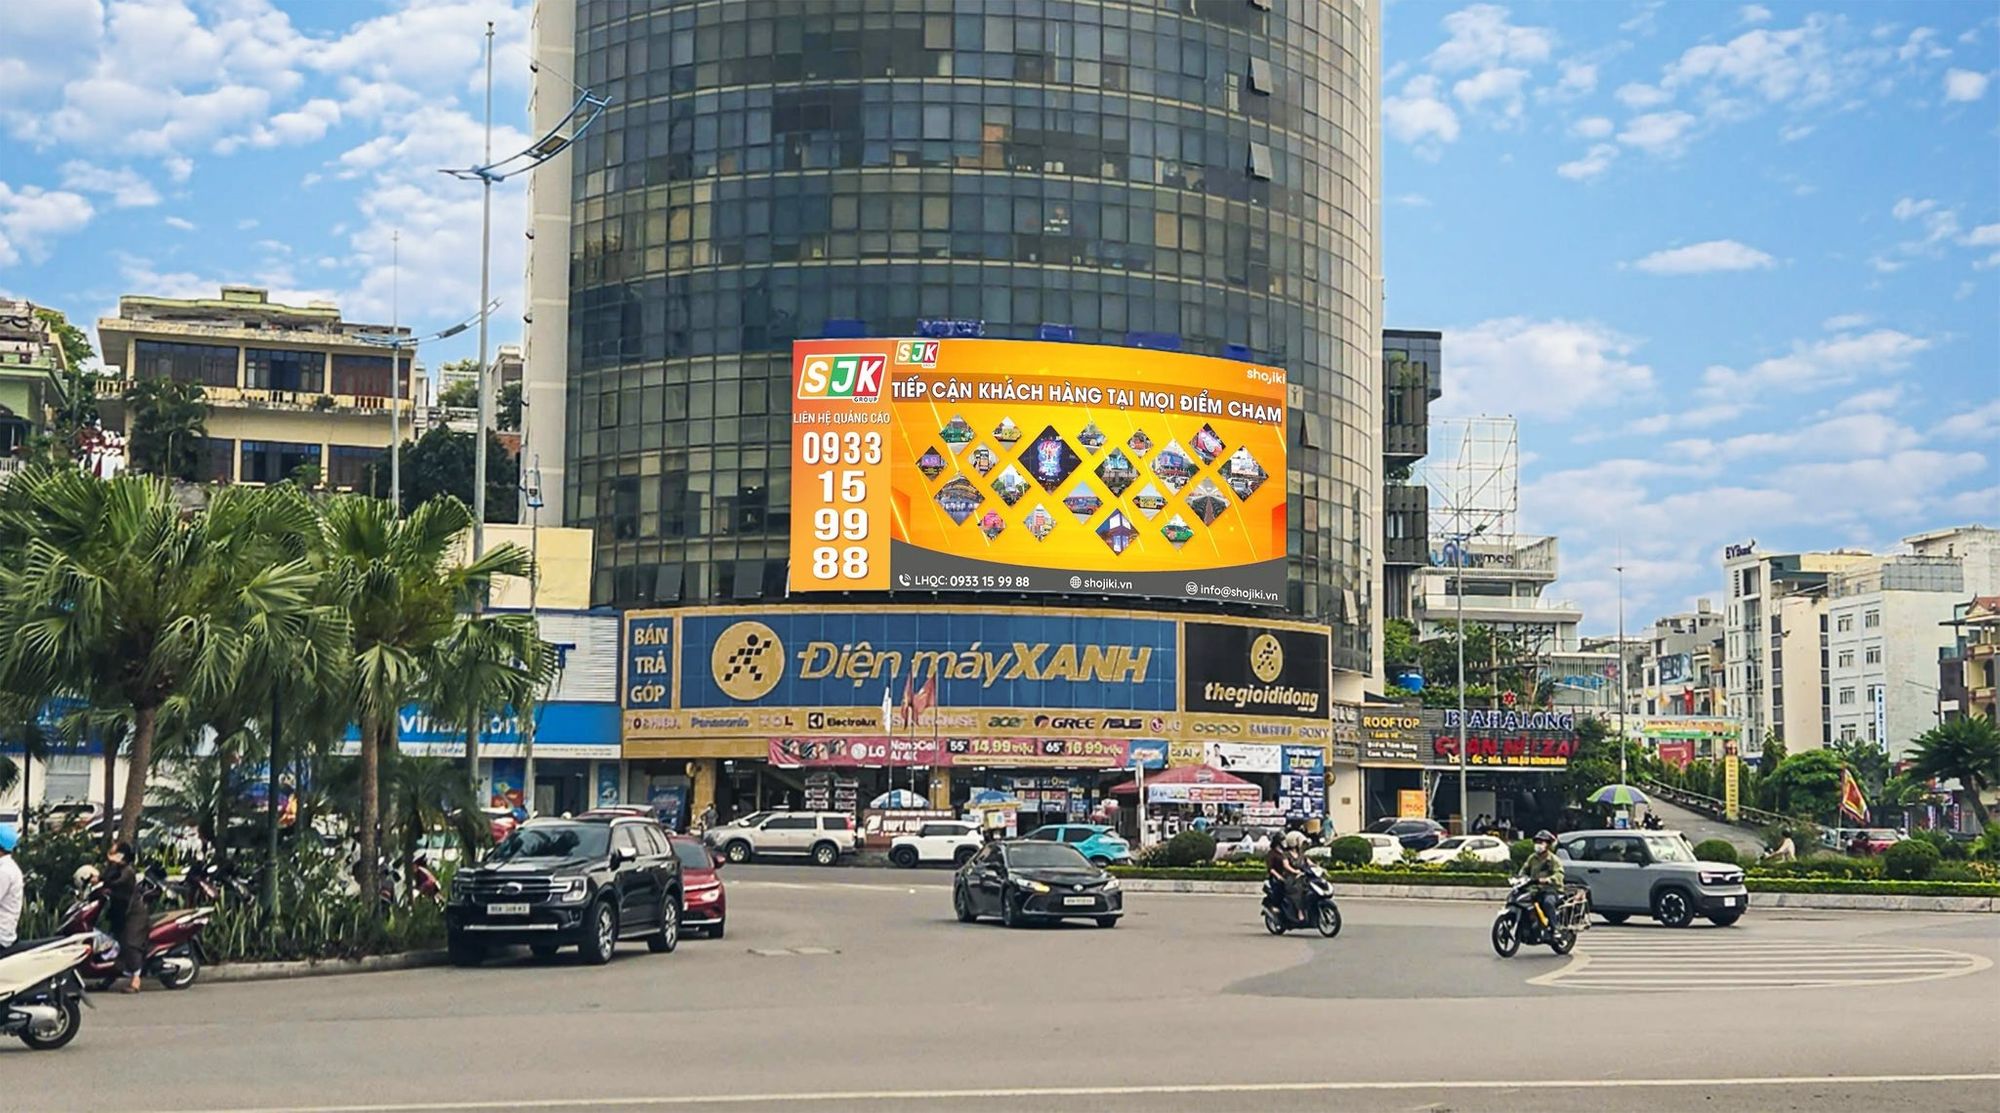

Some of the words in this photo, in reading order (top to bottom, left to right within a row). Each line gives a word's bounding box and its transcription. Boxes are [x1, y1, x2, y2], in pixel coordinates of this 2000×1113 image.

[898, 343, 939, 362] SJK
[804, 360, 883, 393] SJK
[1246, 368, 1287, 385] shojiki
[892, 375, 927, 398] TIẾP
[931, 377, 972, 403] CẬN
[978, 379, 1043, 401] KHÁCH
[1049, 379, 1103, 404] HÀNG
[1107, 387, 1135, 410] TẠI
[1139, 391, 1175, 413] MỌI
[1180, 389, 1222, 415] ĐIỂM
[1227, 400, 1282, 424] CHẠM
[793, 411, 816, 423] LIÊN
[818, 411, 831, 426] HỆ
[870, 410, 890, 424] CÁO
[802, 431, 882, 465] 0933
[818, 470, 867, 503] 15
[814, 508, 869, 541] 99
[812, 546, 869, 580] 88
[915, 575, 948, 587] LHQC:
[950, 575, 979, 587] 0933
[982, 575, 994, 587] 15
[998, 576, 1012, 587] 99
[1015, 576, 1030, 587] 88
[1084, 577, 1133, 591] shojiki.vn
[1200, 584, 1279, 601] info@shojiki.vn
[634, 623, 668, 646] BÁN
[634, 650, 667, 674] TRẢ
[797, 641, 902, 687] Điện
[631, 680, 666, 703] GÓP
[1204, 682, 1319, 712] thegioididong
[827, 718, 877, 728] Electrolux
[988, 716, 1028, 728] acer
[1052, 717, 1095, 729] GREE
[1102, 718, 1142, 729] ASUS
[1363, 716, 1420, 729] ROOFTOP
[1300, 727, 1329, 738] SONY
[868, 747, 886, 757] LG
